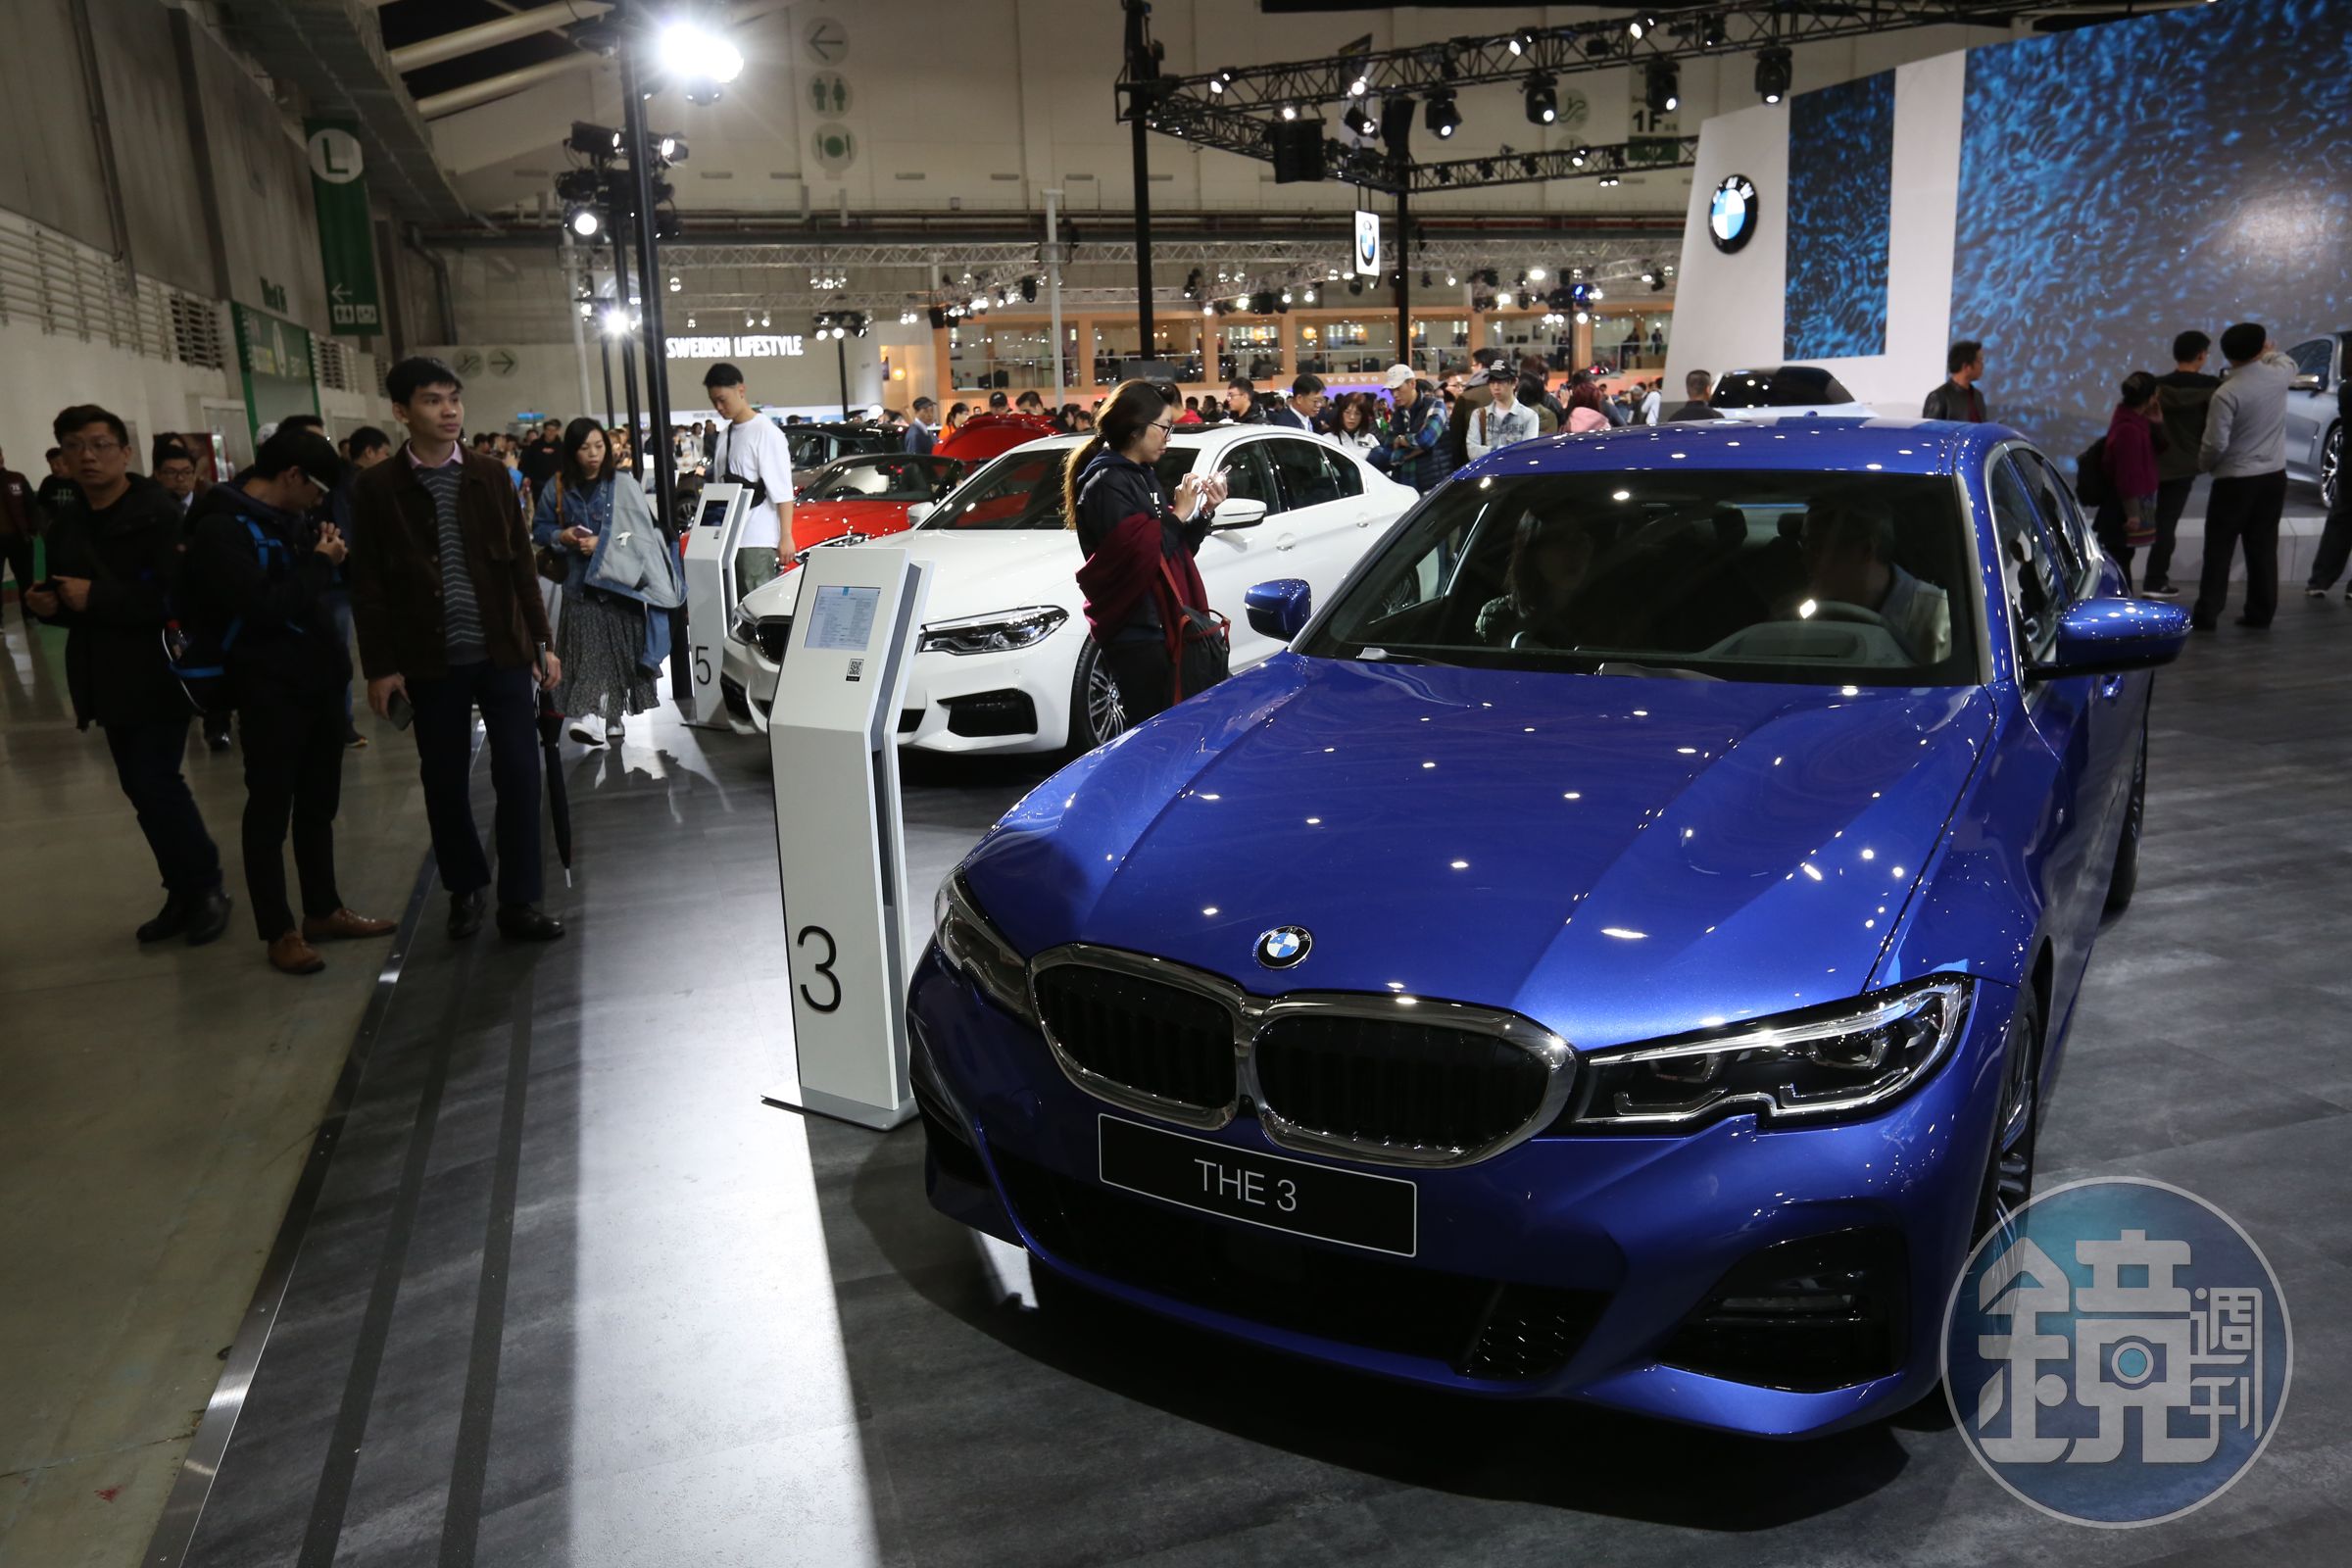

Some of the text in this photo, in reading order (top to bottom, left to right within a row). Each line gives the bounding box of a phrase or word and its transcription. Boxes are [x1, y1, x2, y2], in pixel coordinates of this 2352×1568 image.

[321, 137, 349, 173] L
[665, 335, 804, 359] SWEDISH LIFESTYLE
[696, 645, 711, 685] 5
[797, 925, 842, 1013] 3
[1194, 1157, 1297, 1212] THE 3
